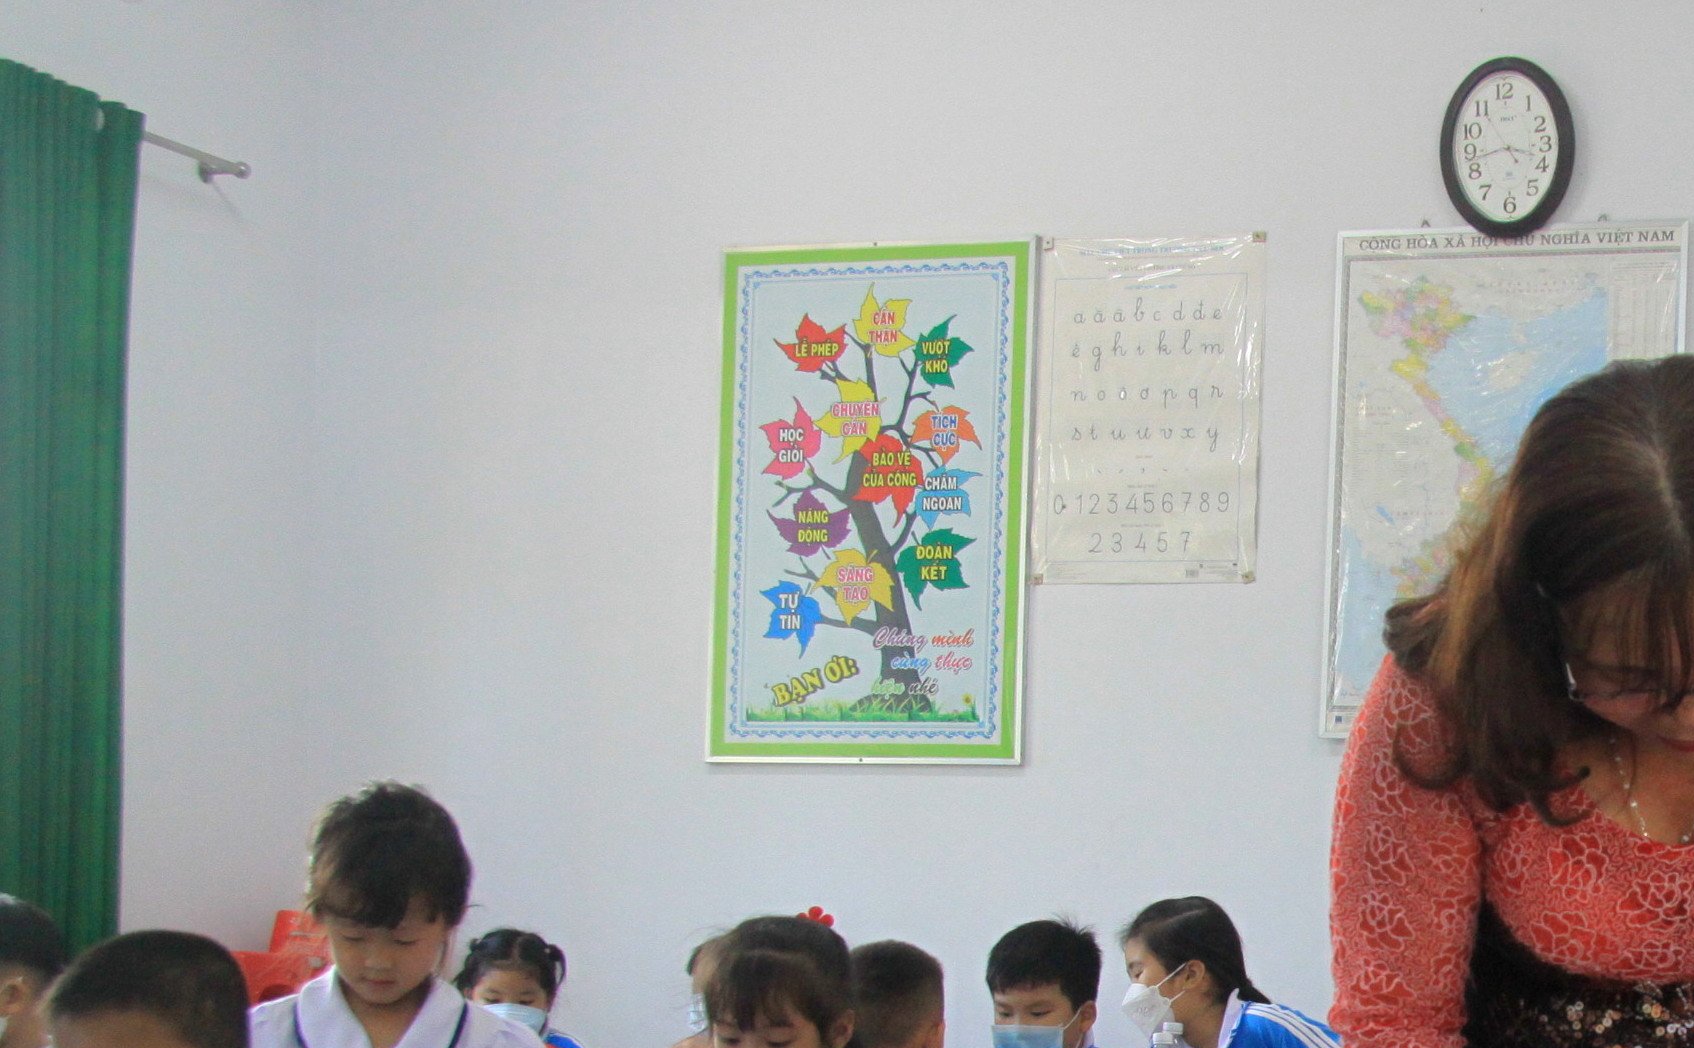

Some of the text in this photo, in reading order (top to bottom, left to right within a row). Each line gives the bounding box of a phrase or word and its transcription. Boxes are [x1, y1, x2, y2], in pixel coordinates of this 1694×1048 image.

[1496, 83, 1513, 100] 12
[1475, 100, 1489, 117] 11
[1526, 95, 1531, 112] 1
[1463, 123, 1482, 140] 10
[1534, 116, 1546, 133] 2
[1464, 143, 1477, 161] 9
[1539, 136, 1552, 153] 3
[1468, 162, 1482, 179] 8
[1535, 155, 1549, 173] 4
[1479, 184, 1492, 201] 7
[1526, 179, 1539, 196] 5
[1503, 196, 1516, 214] 6
[1597, 229, 1634, 246] VIỆT
[1638, 230, 1675, 242] NAM
[922, 497, 962, 512] NGOAN
[1053, 492, 1230, 515] 0 1 2 3 4 5 6 7 8 9
[1089, 531, 1193, 553] 2 3 4 5 7
[779, 614, 801, 630] TIN
